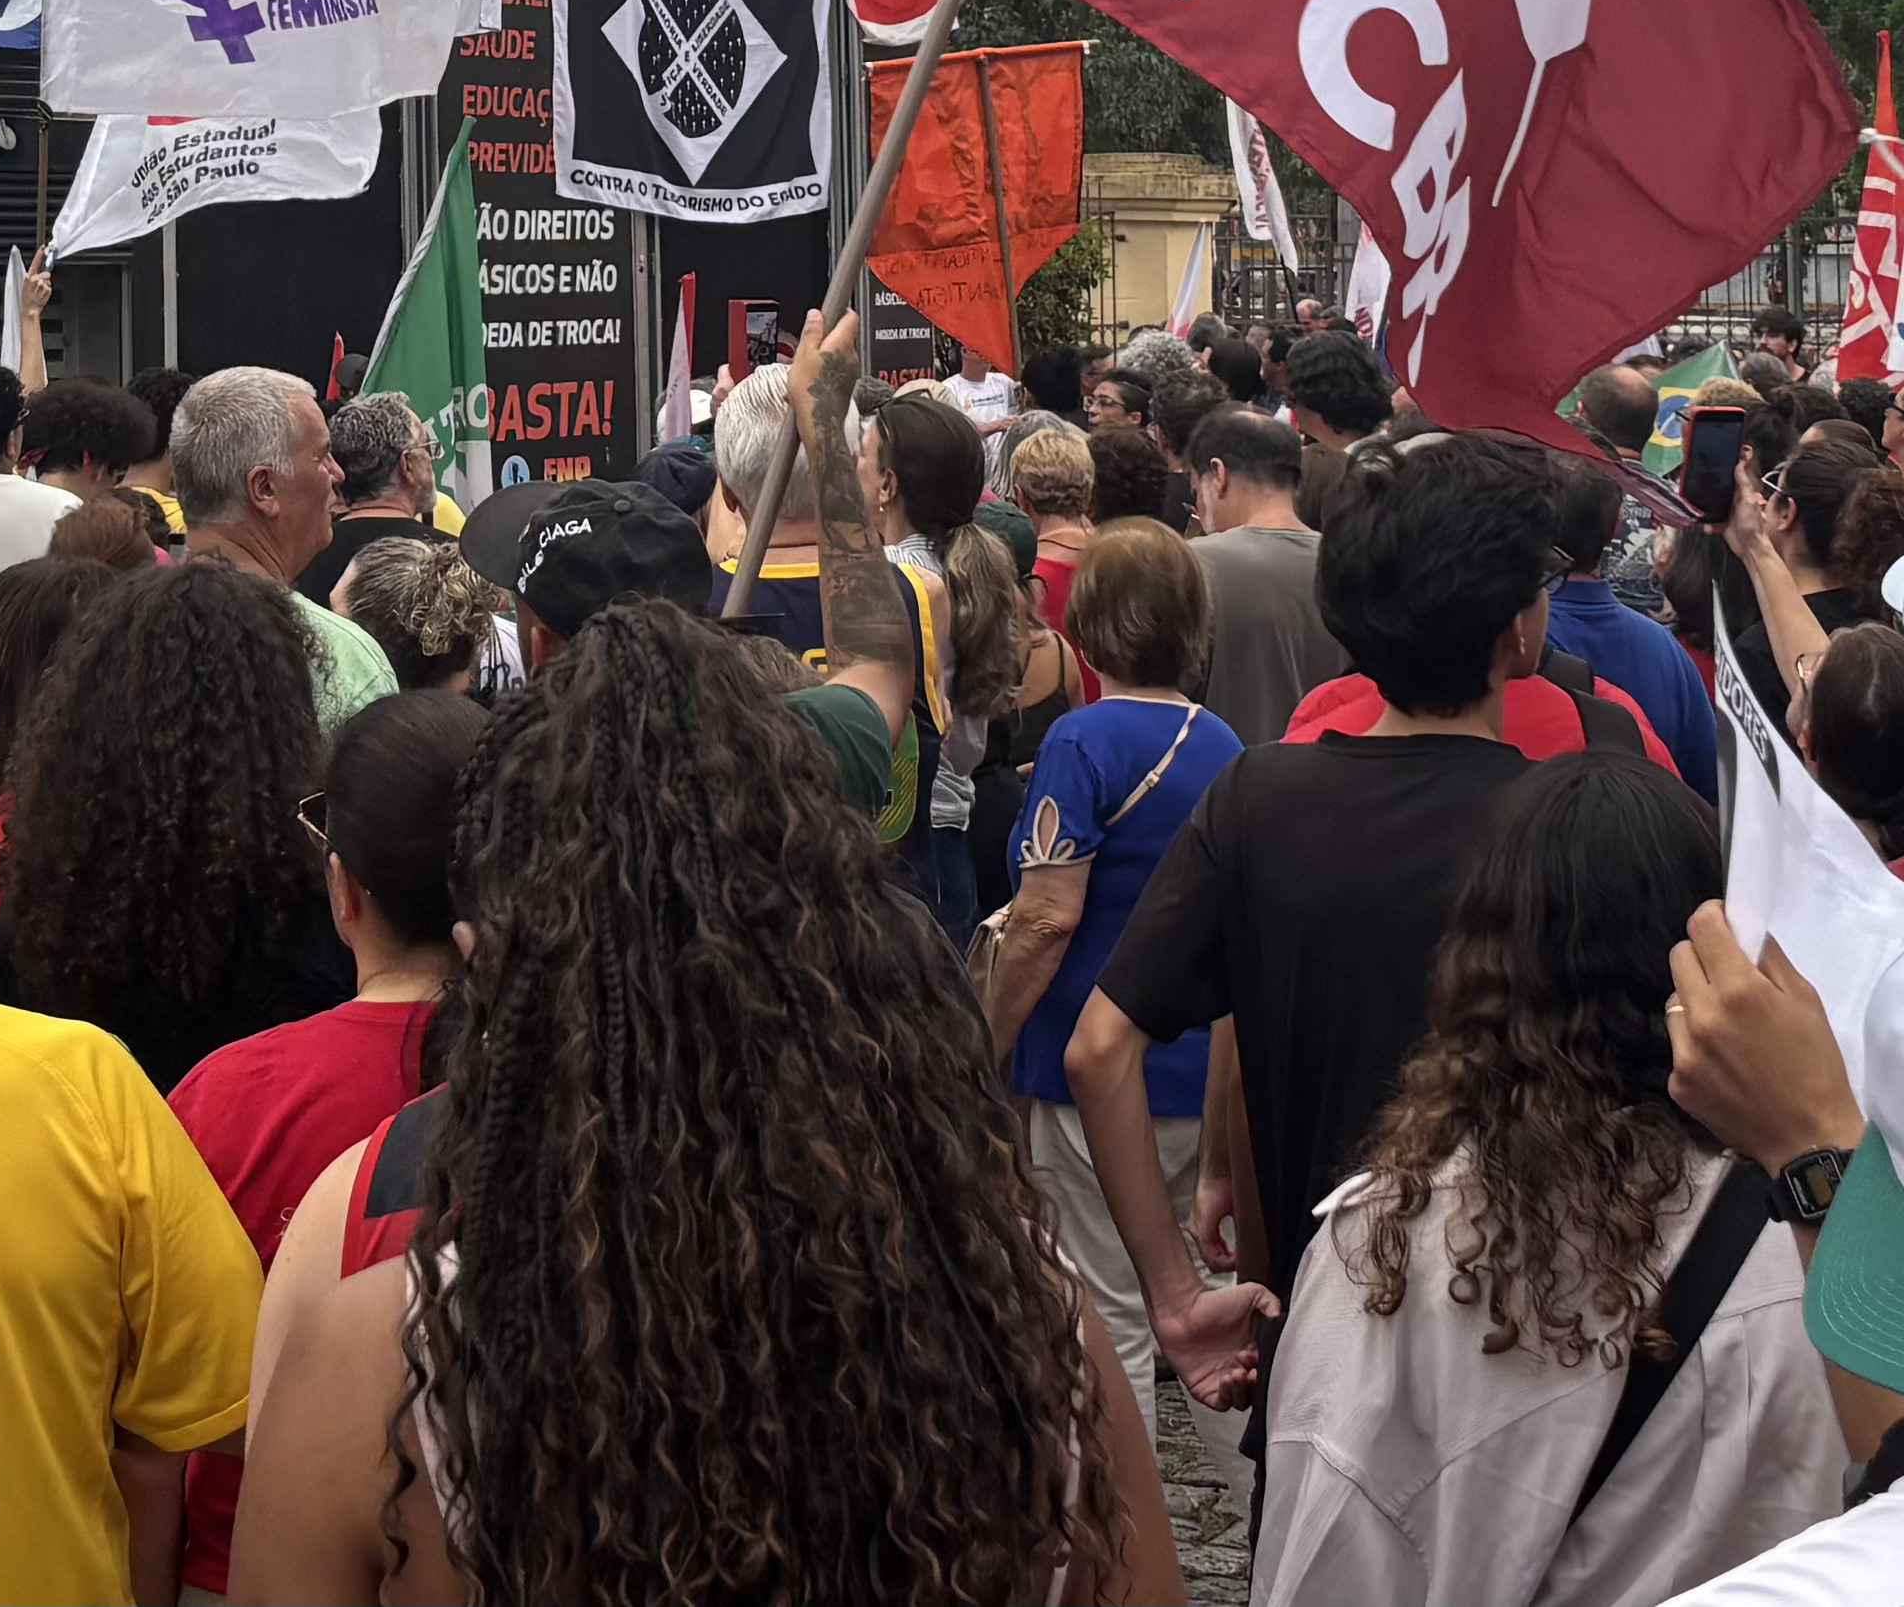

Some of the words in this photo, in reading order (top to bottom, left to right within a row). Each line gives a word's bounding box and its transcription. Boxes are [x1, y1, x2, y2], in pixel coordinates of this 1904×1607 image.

[130, 146, 167, 189] União
[172, 118, 278, 152] Estadual
[158, 140, 279, 186] Estudantes
[166, 177, 190, 208] São
[194, 158, 261, 185] Paulo
[569, 167, 635, 196] CONTRA
[637, 181, 649, 196] O
[736, 194, 765, 213] DO
[475, 203, 508, 241] ÃO
[513, 208, 616, 242] DIREITOS
[478, 258, 555, 296] ÁSICOS
[559, 267, 573, 295] E
[574, 259, 619, 294] NÃO
[527, 320, 553, 347] DE
[555, 318, 622, 346] TROCA!
